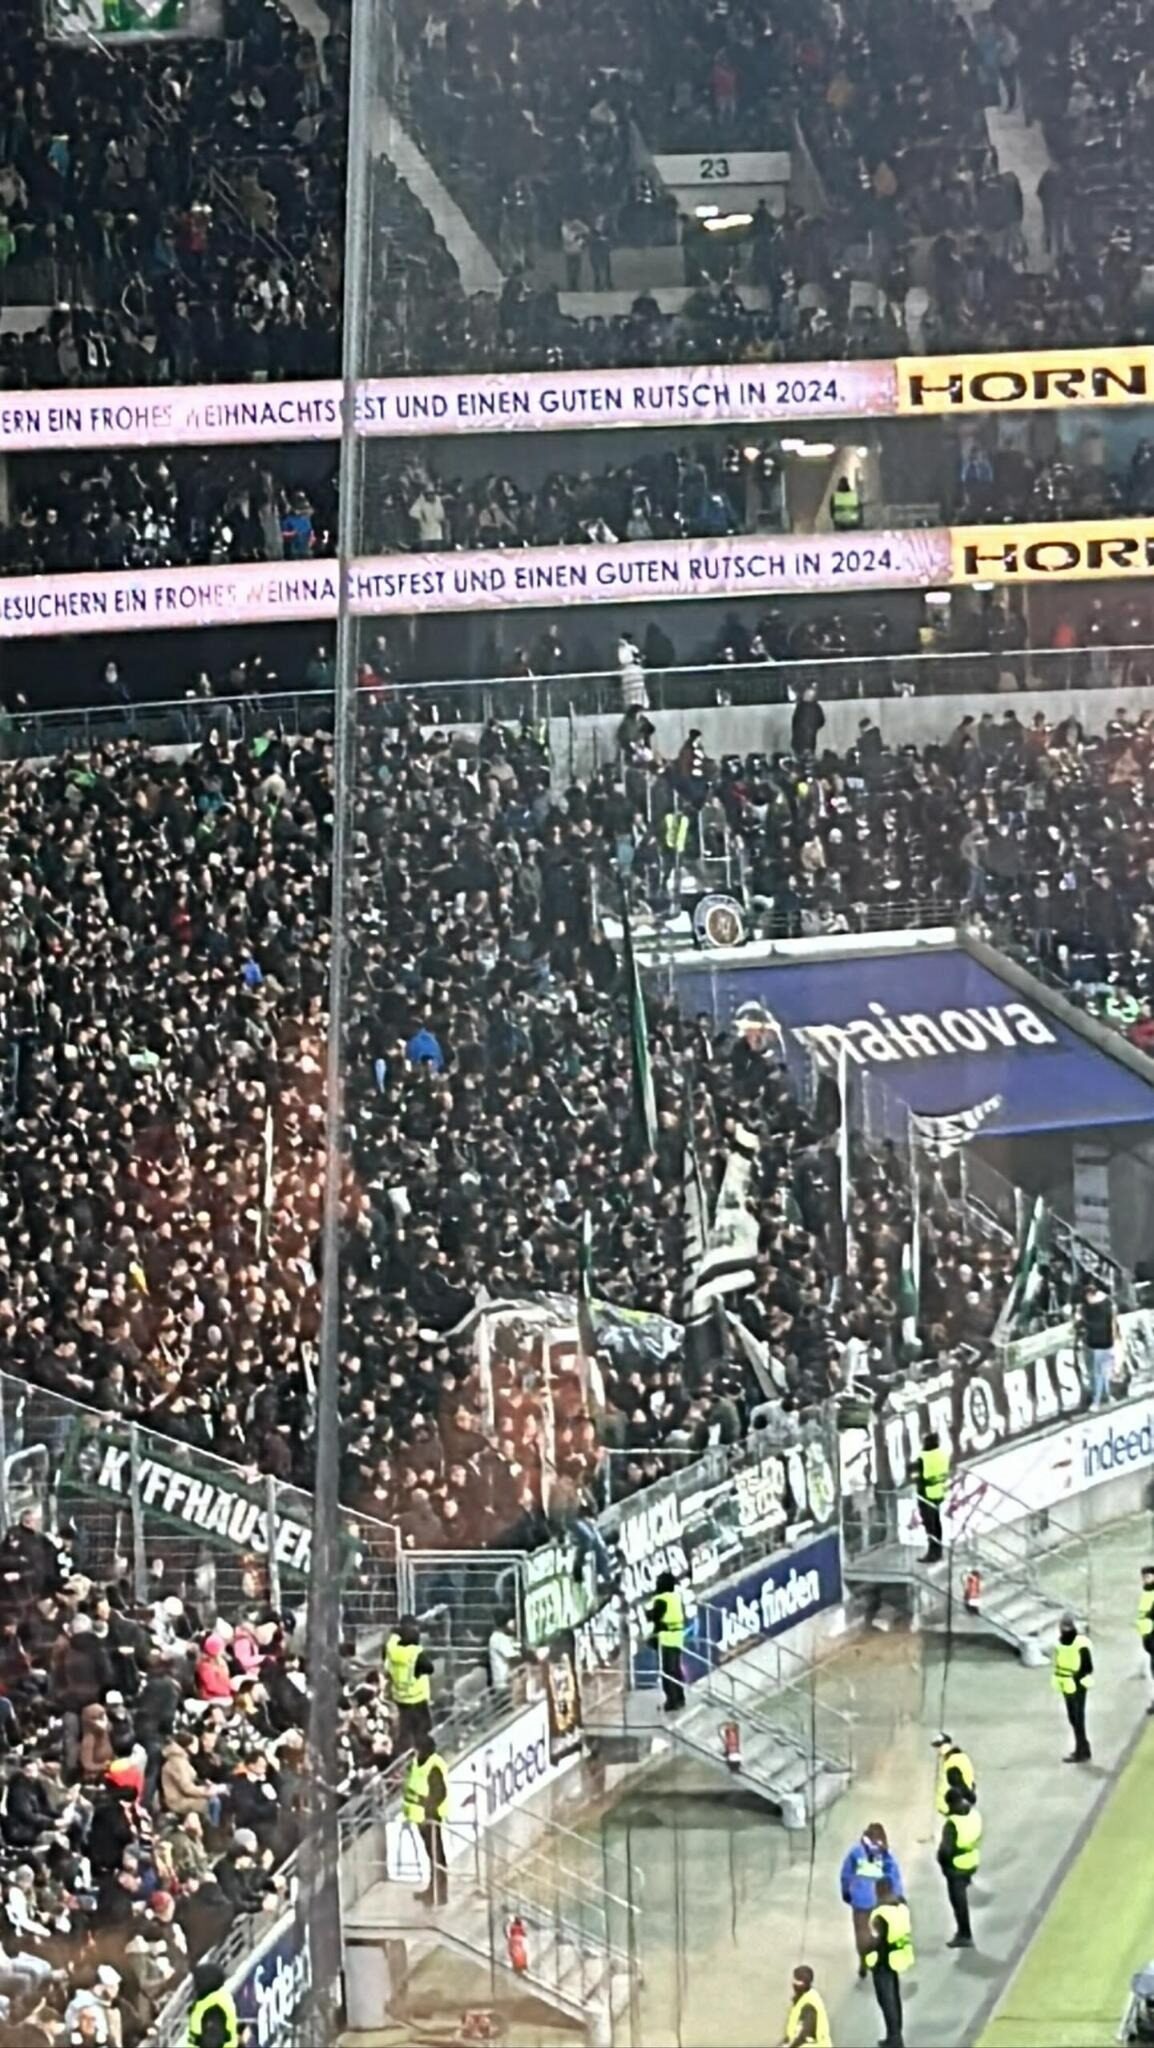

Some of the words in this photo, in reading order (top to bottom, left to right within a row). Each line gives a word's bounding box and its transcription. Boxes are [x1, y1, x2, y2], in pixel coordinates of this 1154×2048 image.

[700, 158, 730, 179] 23
[48, 408, 82, 432] EIN
[90, 404, 172, 432] FROHES
[186, 397, 387, 428] WEIHNACHTSEST
[396, 394, 449, 418] UND
[457, 391, 530, 416] EINEN
[539, 388, 623, 413] GUTEN
[634, 383, 730, 409] RUTSCH
[740, 382, 766, 404] IN
[776, 379, 846, 404] 2024.
[909, 365, 1147, 406] HORN
[0, 592, 107, 621] ESUCHERN
[115, 589, 147, 612] EIN
[155, 584, 236, 612] FROHES
[454, 568, 506, 593] UND
[515, 564, 587, 588] EINEN
[597, 560, 679, 584] GUTEN
[689, 554, 786, 580] RUTSCH
[795, 553, 821, 574] IN
[831, 549, 902, 574] 2024.
[963, 537, 1154, 575] HOR
[790, 1001, 1057, 1065] mainova
[716, 1595, 760, 1652] Jobs
[761, 1567, 820, 1629] finden
[485, 1722, 547, 1815] indeed
